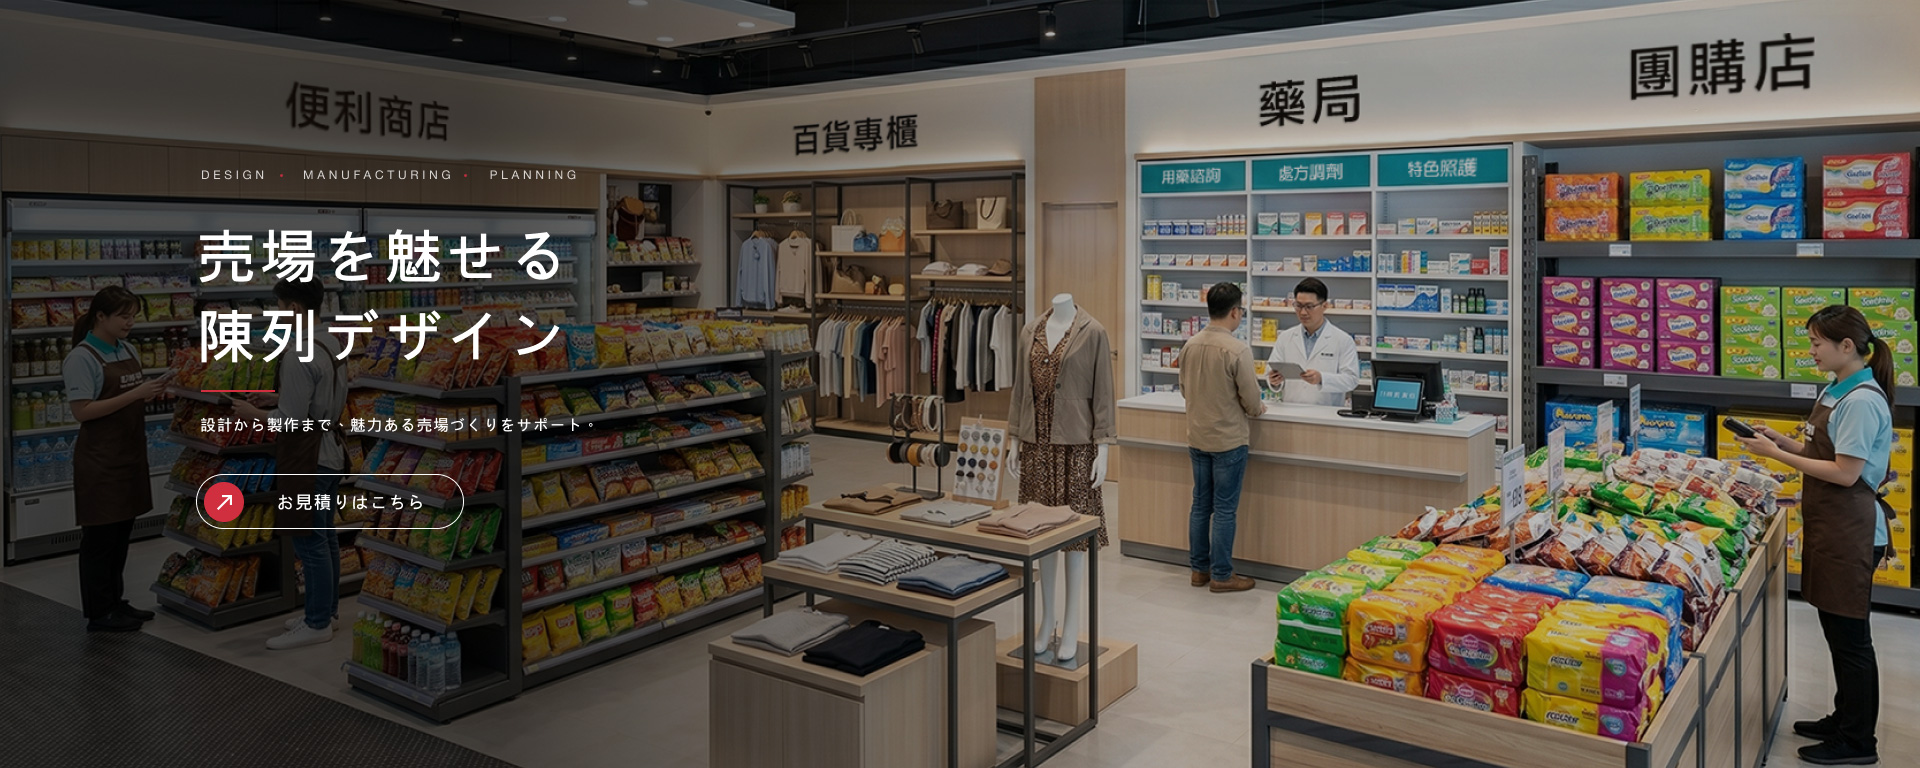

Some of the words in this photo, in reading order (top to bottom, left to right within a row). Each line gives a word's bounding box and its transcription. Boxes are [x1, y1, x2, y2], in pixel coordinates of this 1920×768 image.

[1631, 33, 1814, 100] 團購店
[286, 82, 449, 141] 便利商店
[1259, 74, 1360, 127] 藥局
[793, 114, 918, 155] 百貨專櫃
[1407, 157, 1478, 178] 特色照護
